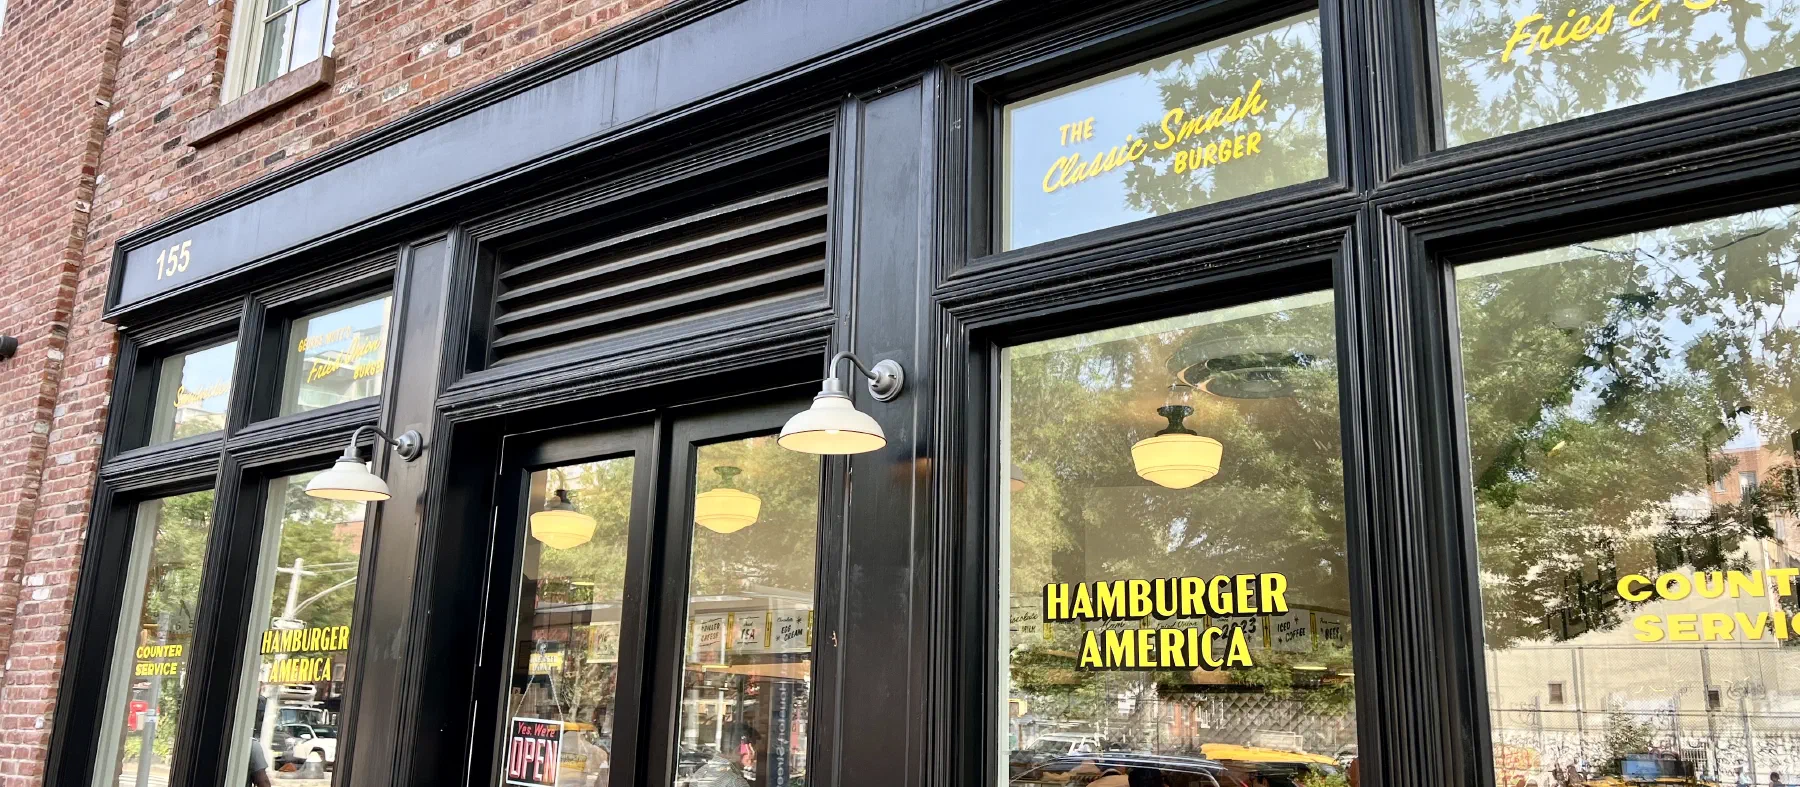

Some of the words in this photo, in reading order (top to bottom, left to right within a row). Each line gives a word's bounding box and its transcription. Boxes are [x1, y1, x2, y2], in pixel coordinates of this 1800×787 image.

[1501, 5, 1616, 62] Fries
[1042, 134, 1148, 193] Classic
[1154, 79, 1268, 150] Smash
[1060, 117, 1095, 146] THE
[1173, 131, 1262, 174] BURGER
[156, 239, 192, 280] 155
[1043, 572, 1289, 623] HAMBURGER
[1617, 568, 1799, 602] COUNT
[260, 626, 350, 654] HAMBURGER
[783, 628, 804, 642] CREAM
[1278, 621, 1291, 632] ICED
[1285, 627, 1306, 642] COFFEE
[1633, 611, 1800, 642] SERVI
[136, 645, 183, 659] COUNTER
[1076, 626, 1254, 670] AMERICA
[135, 662, 178, 676] SERVICE
[268, 657, 332, 682] AMERICA
[509, 737, 559, 784] OPEN
